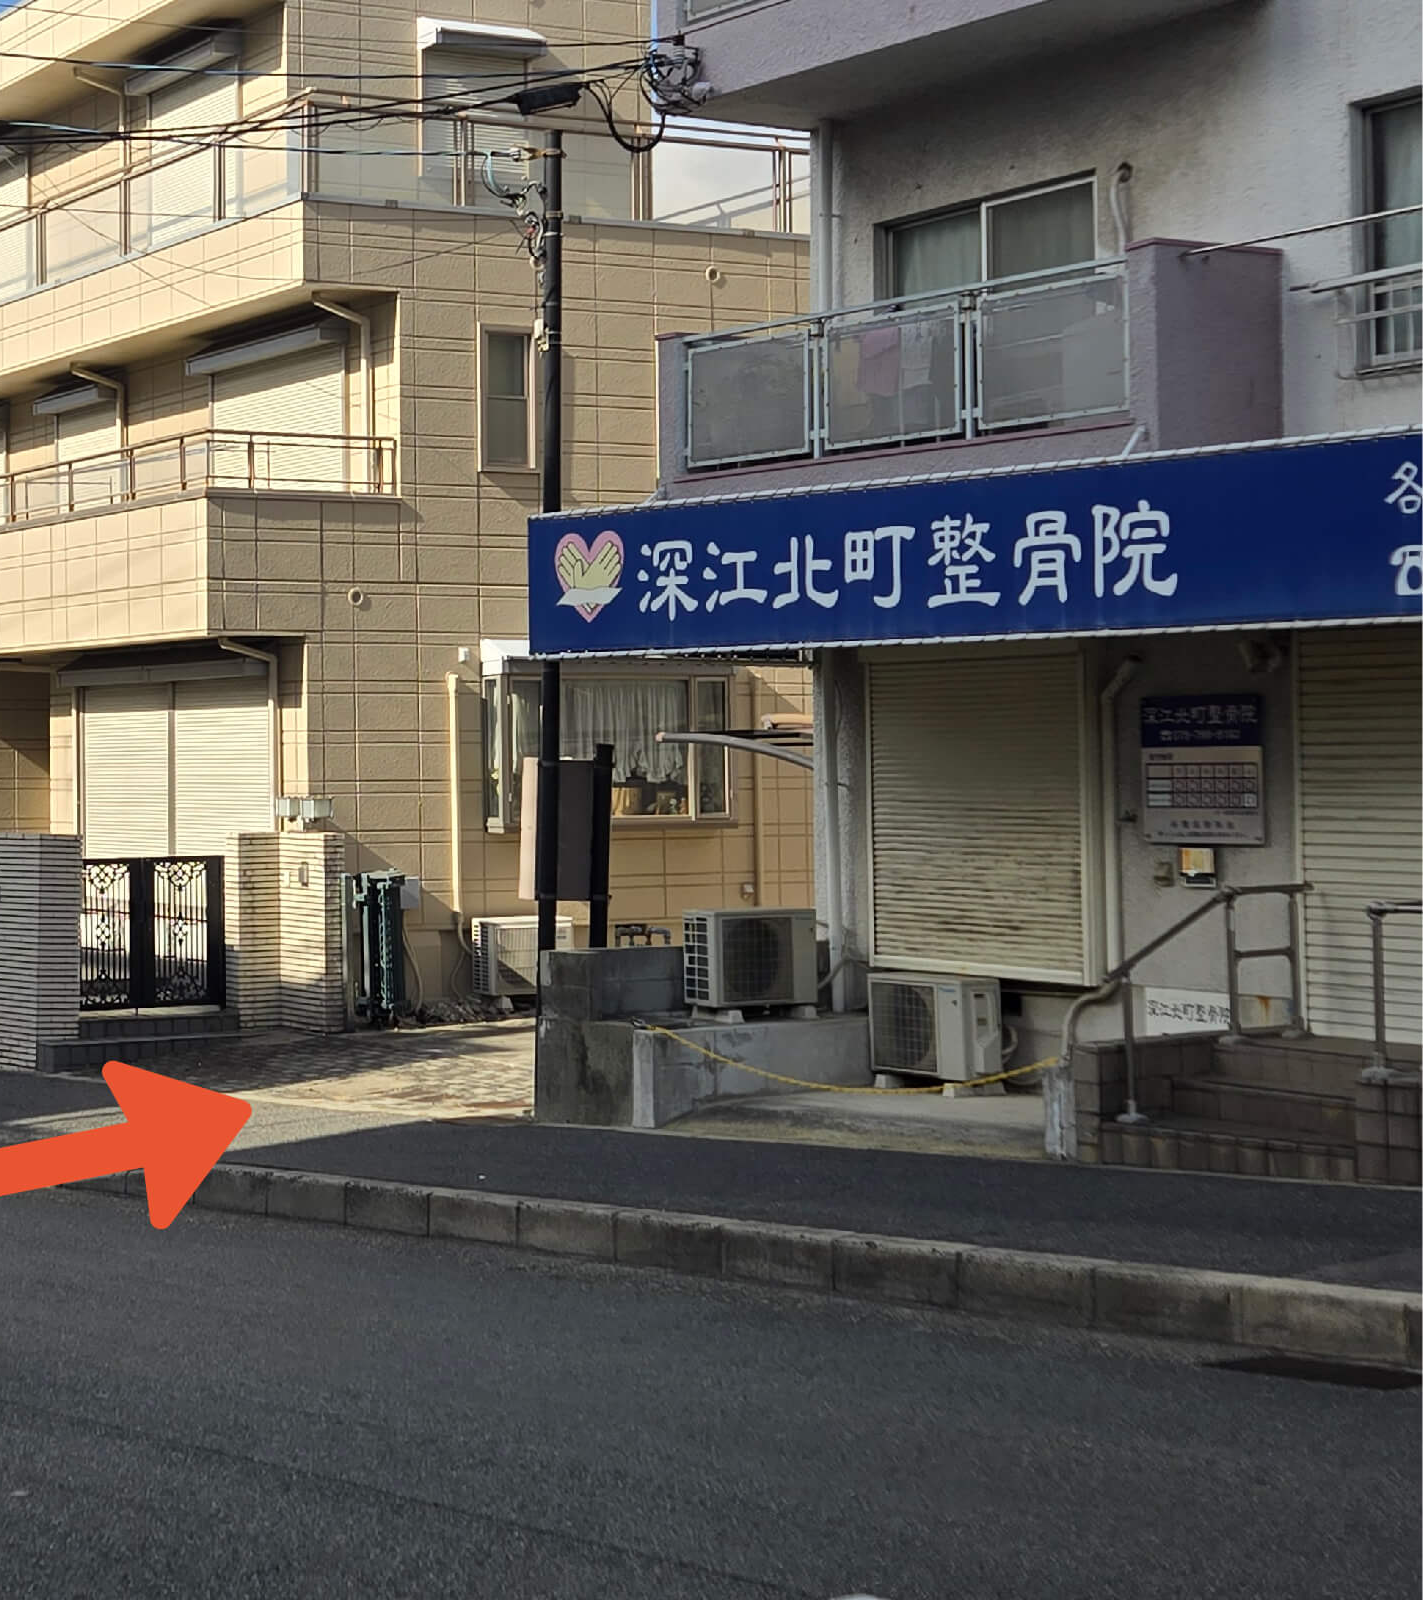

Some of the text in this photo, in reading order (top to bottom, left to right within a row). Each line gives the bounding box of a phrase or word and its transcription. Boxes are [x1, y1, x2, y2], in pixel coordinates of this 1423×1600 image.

[636, 499, 1179, 621] 深江北町整骨院
